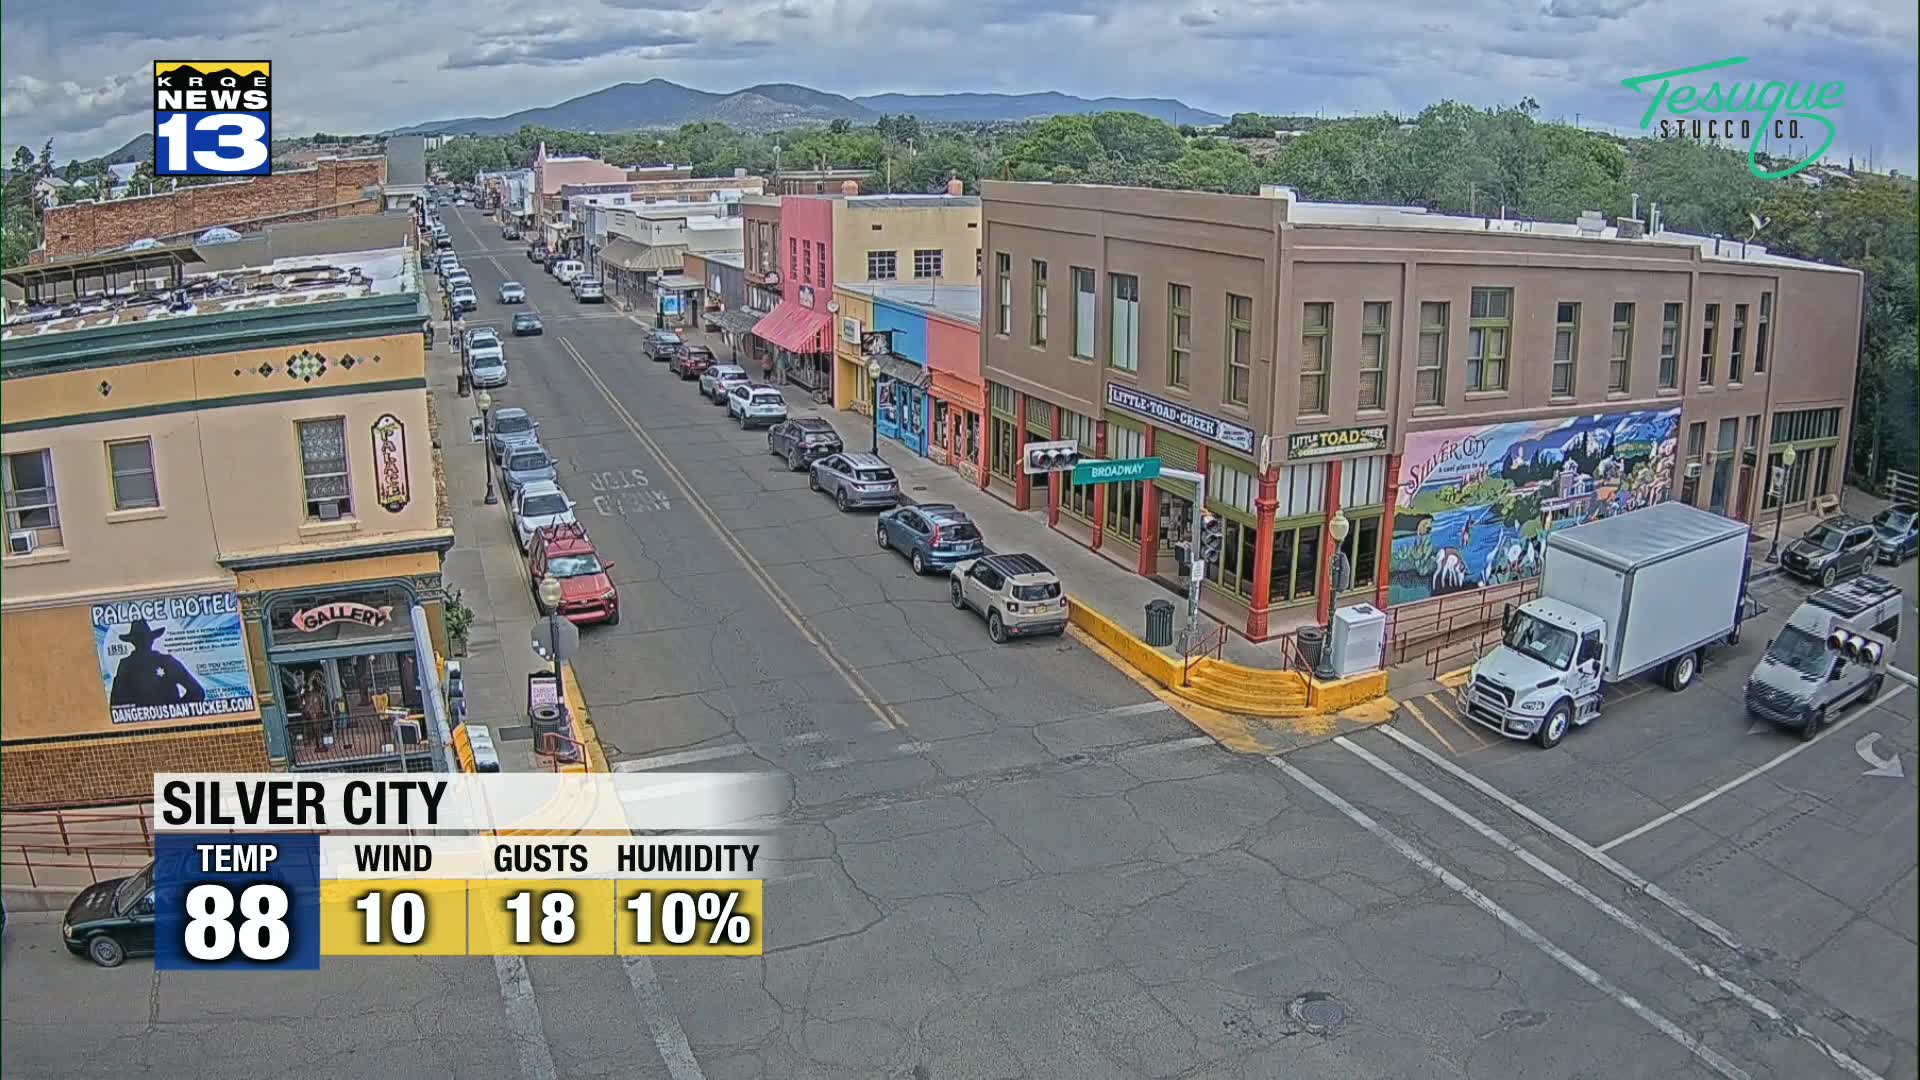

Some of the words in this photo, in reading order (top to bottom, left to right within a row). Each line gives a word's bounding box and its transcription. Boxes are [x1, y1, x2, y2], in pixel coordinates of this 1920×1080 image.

[1113, 389, 1147, 410] LITTLE
[1150, 400, 1177, 421] TOAD
[1180, 411, 1215, 435] CREEK
[1292, 434, 1318, 449] LITTLE
[1320, 430, 1360, 447] TOAD
[1462, 435, 1494, 460] CITY
[1091, 463, 1144, 478] BROADWAY
[92, 599, 168, 625] PALACE
[170, 593, 237, 618] HOTEL
[304, 606, 385, 628] GALLERY
